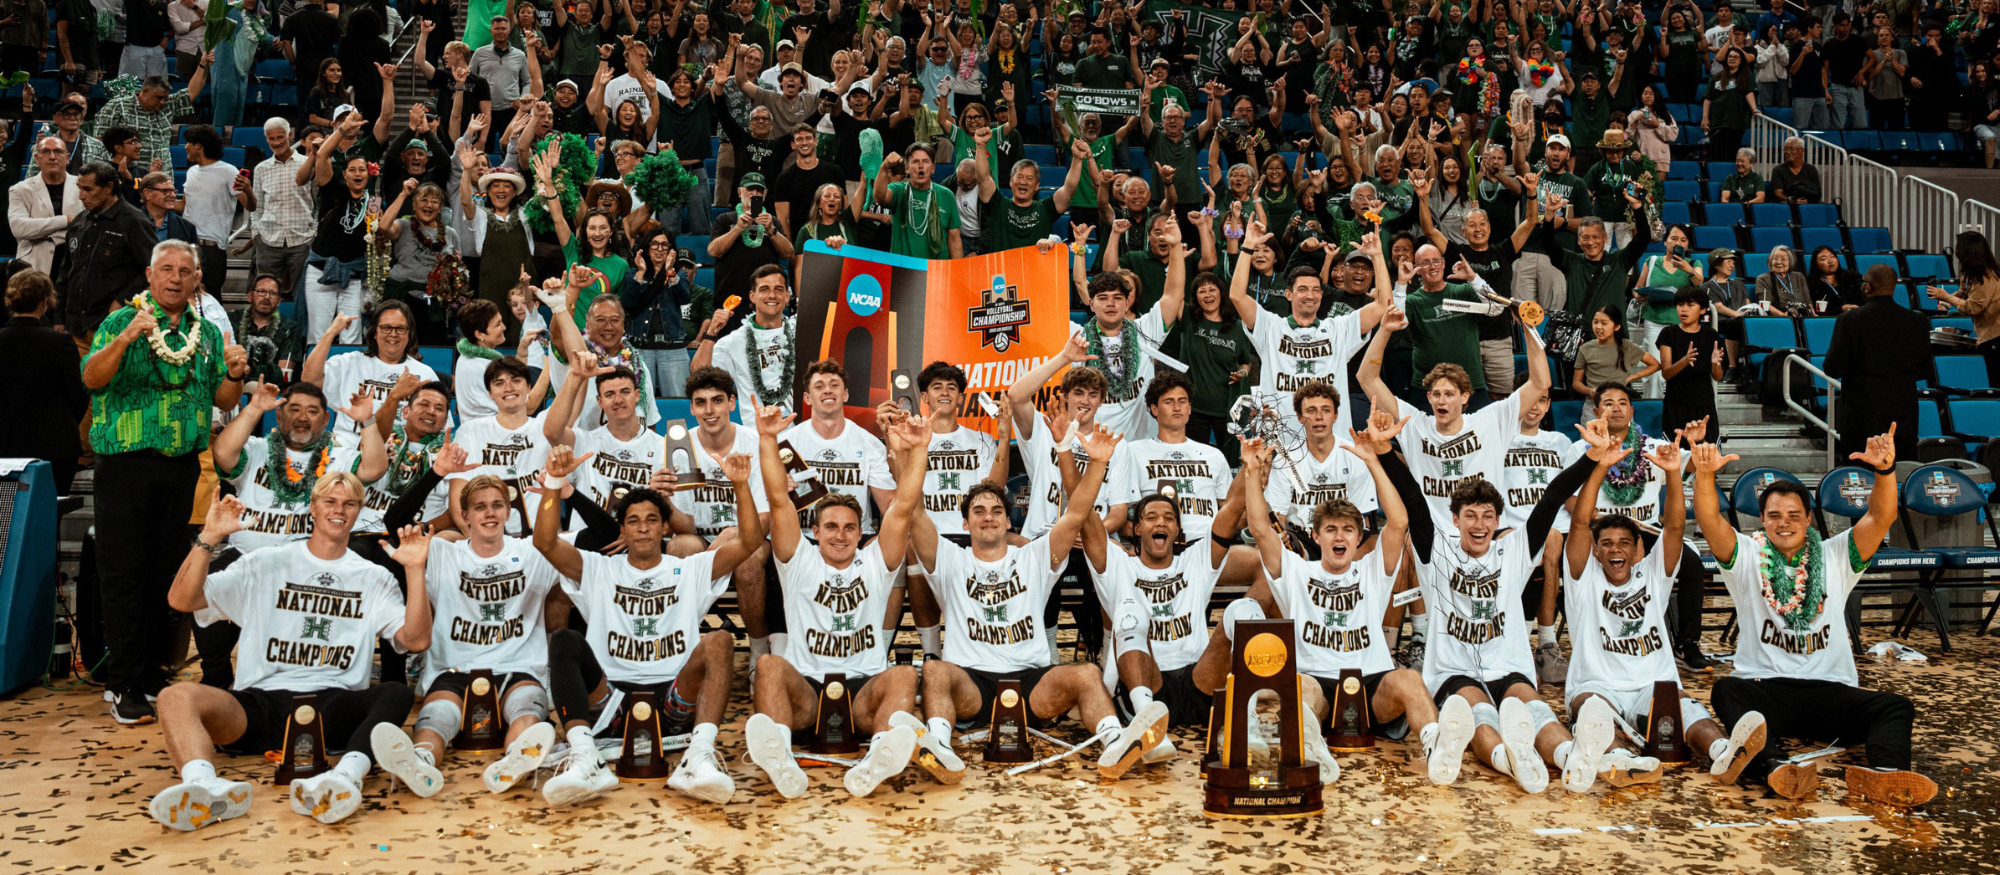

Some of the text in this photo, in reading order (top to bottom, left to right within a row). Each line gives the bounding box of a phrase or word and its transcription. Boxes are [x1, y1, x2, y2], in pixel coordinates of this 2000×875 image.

[618, 87, 644, 97] RAINB
[1075, 94, 1127, 106] GO'BOWS
[850, 293, 881, 308] NCAA
[973, 310, 1026, 327] CHAMPIONSHIP
[986, 305, 1014, 316] VOLLEYBALL
[1421, 436, 1482, 459] NAIONAL
[926, 455, 980, 471] ATIONAL
[1146, 463, 1213, 479] NATIONAL
[1508, 488, 1545, 507] CHAMP
[1877, 558, 1910, 566] CHAMPIONS
[1922, 557, 1936, 565] HERE
[1142, 578, 1188, 602] TIONAL
[1451, 571, 1500, 599] NATION
[276, 589, 364, 619] NATIONAL
[814, 578, 869, 614] NAIONAL
[1234, 795, 1302, 806] NATIONAL CHAMPION
